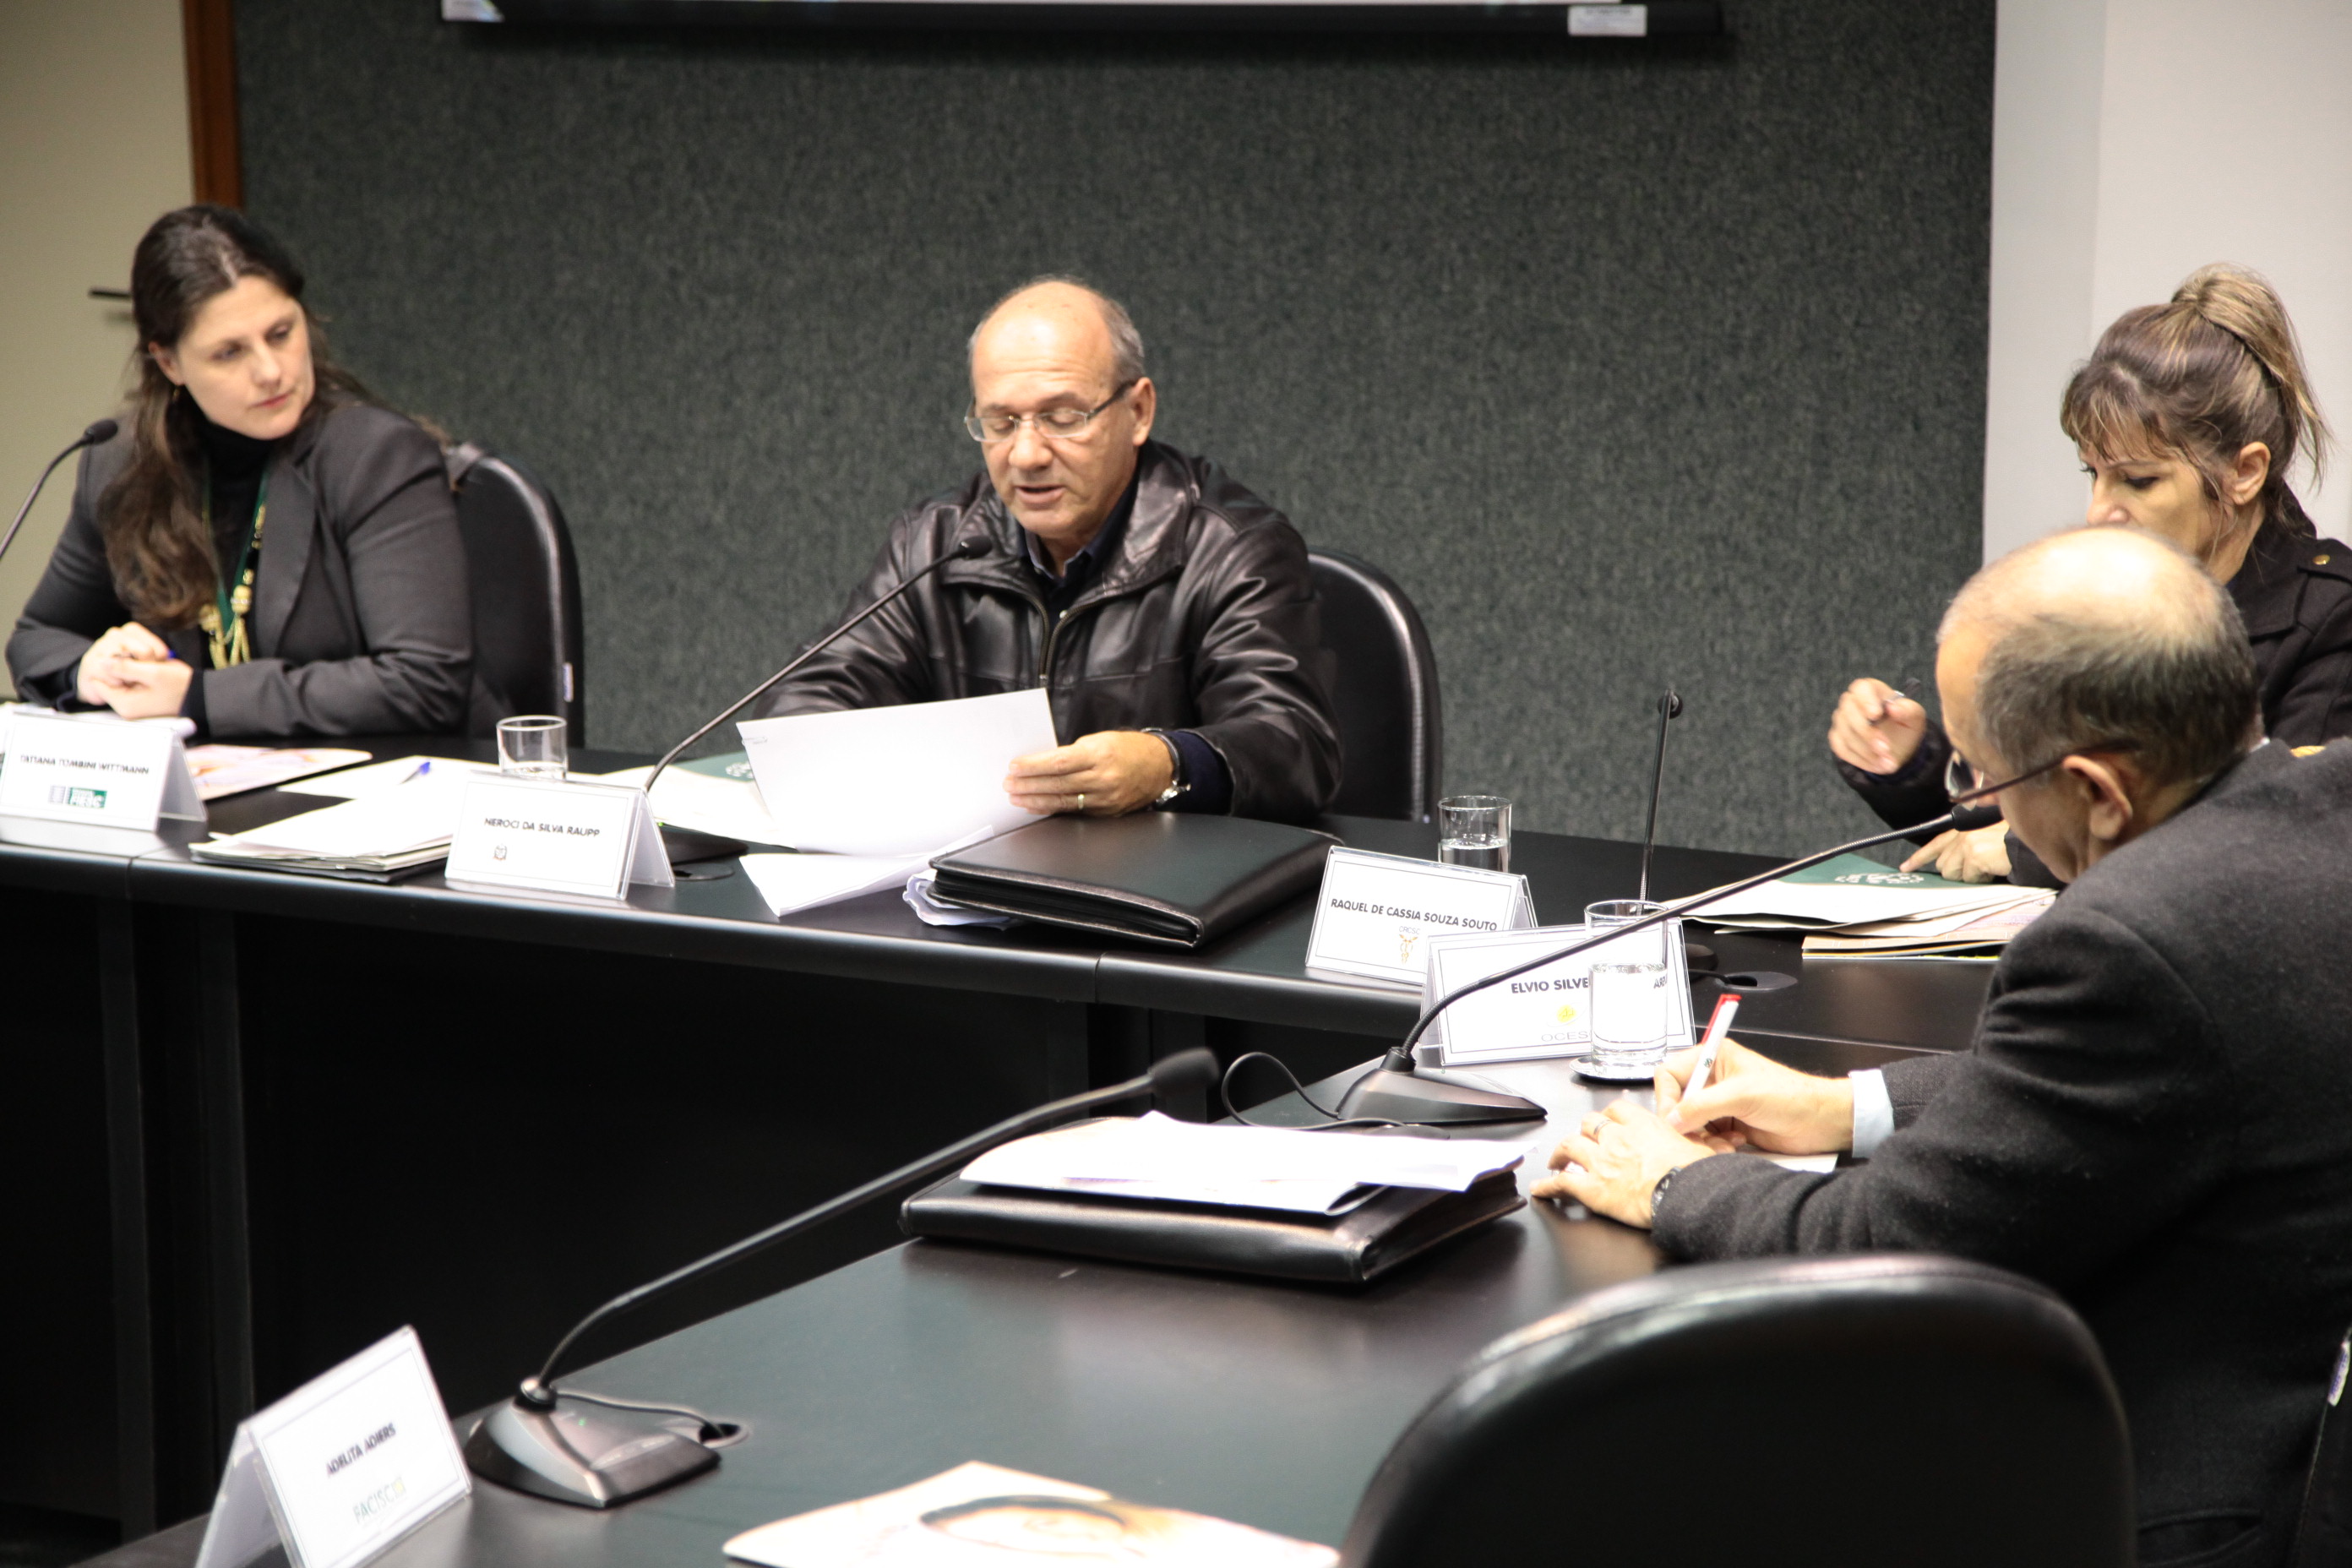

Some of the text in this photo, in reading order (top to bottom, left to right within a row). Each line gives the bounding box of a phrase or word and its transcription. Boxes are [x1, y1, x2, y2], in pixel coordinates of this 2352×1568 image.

[20, 754, 56, 765] TATIANA
[522, 821, 535, 830] DA
[538, 823, 564, 834] SILVA
[567, 826, 600, 836] RAUPP
[1331, 898, 1497, 931] RAQUEL DE CASSIA SOUZA SOUTO
[1399, 925, 1420, 934] CRCSC
[1511, 977, 1589, 994] ELVIO SILVE
[1541, 1030, 1589, 1042] OCES
[326, 1444, 363, 1477] ADELITA
